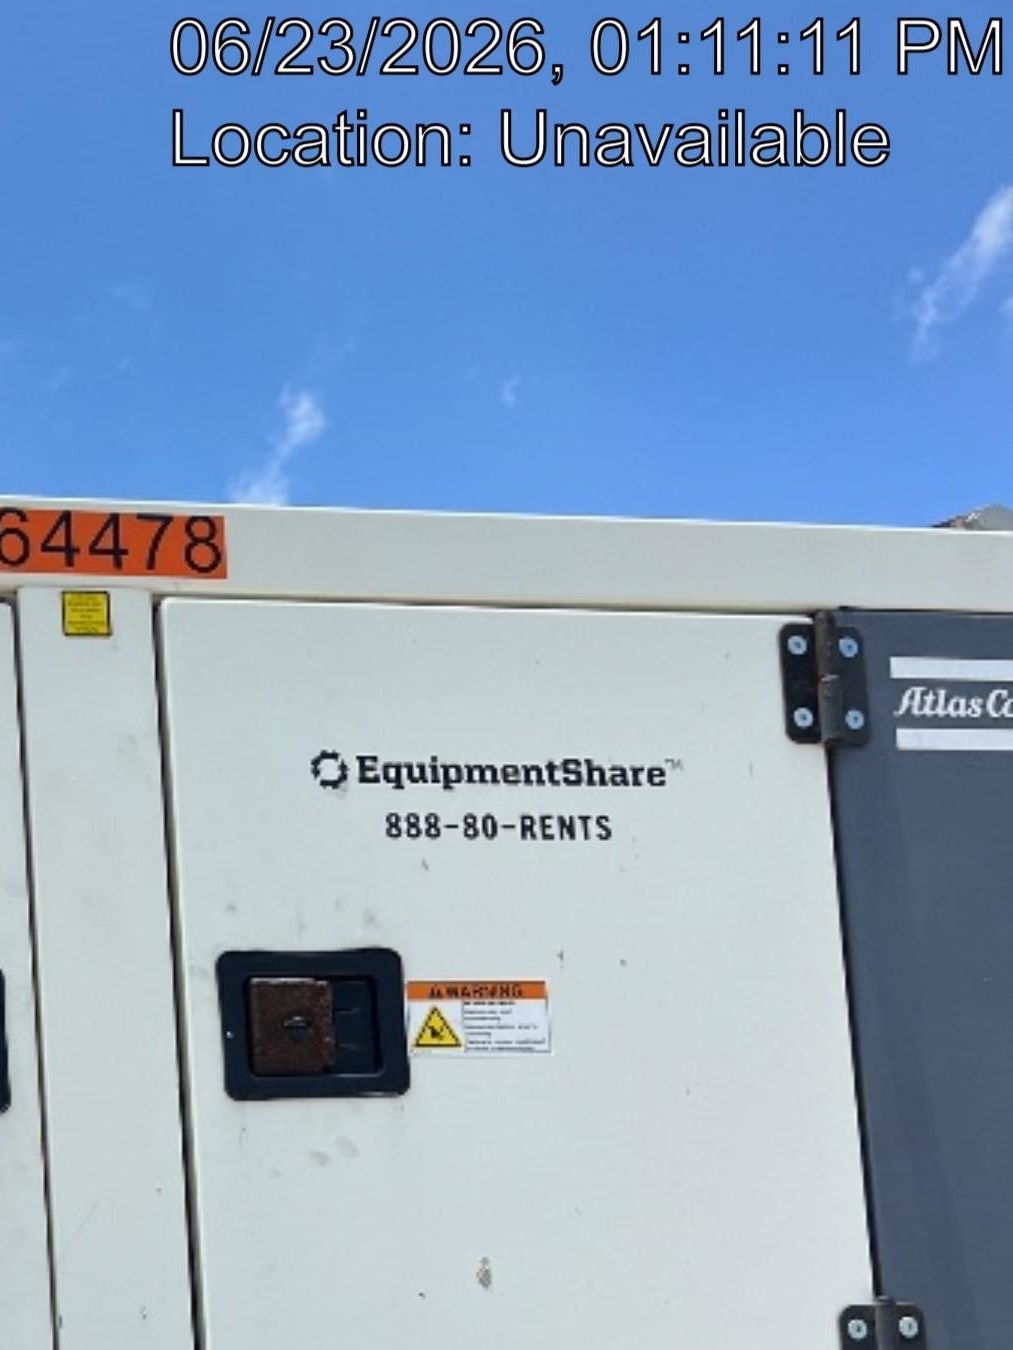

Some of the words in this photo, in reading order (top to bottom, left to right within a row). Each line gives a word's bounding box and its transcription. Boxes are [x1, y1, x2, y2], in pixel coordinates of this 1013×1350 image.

[892, 685, 985, 719] Atlas
[385, 812, 613, 841] 888-80-RENTS
[446, 984, 524, 999] WARNING
